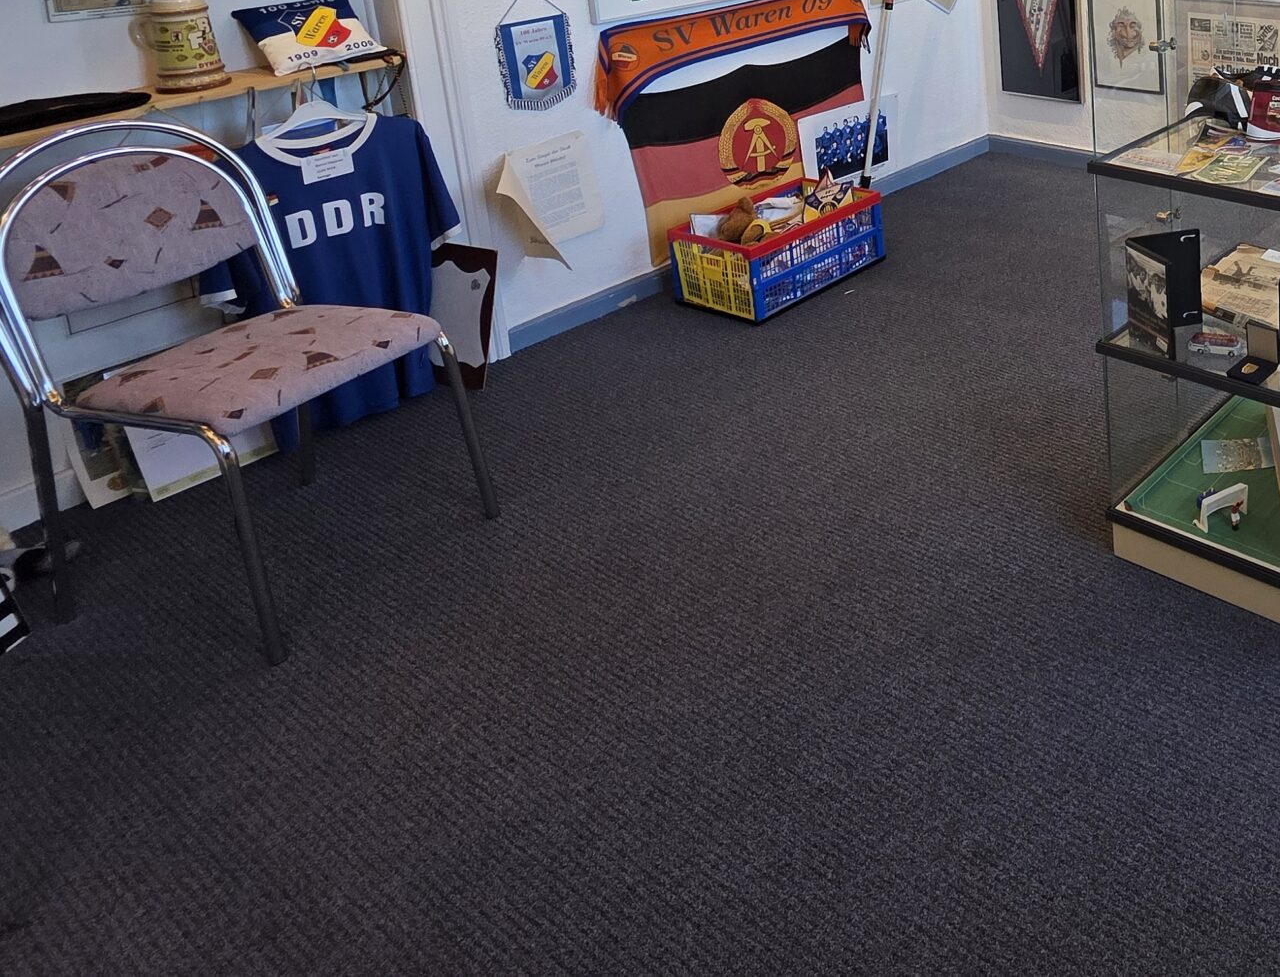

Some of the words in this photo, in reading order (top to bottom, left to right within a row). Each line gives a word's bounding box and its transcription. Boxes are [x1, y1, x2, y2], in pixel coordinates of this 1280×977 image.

[303, 14, 328, 40] Waren
[651, 22, 699, 53] SV
[708, 4, 793, 39] Waren
[287, 49, 319, 63] 1909
[344, 39, 375, 52] 2009
[1256, 52, 1279, 67] Noch
[284, 192, 386, 249] DDR
